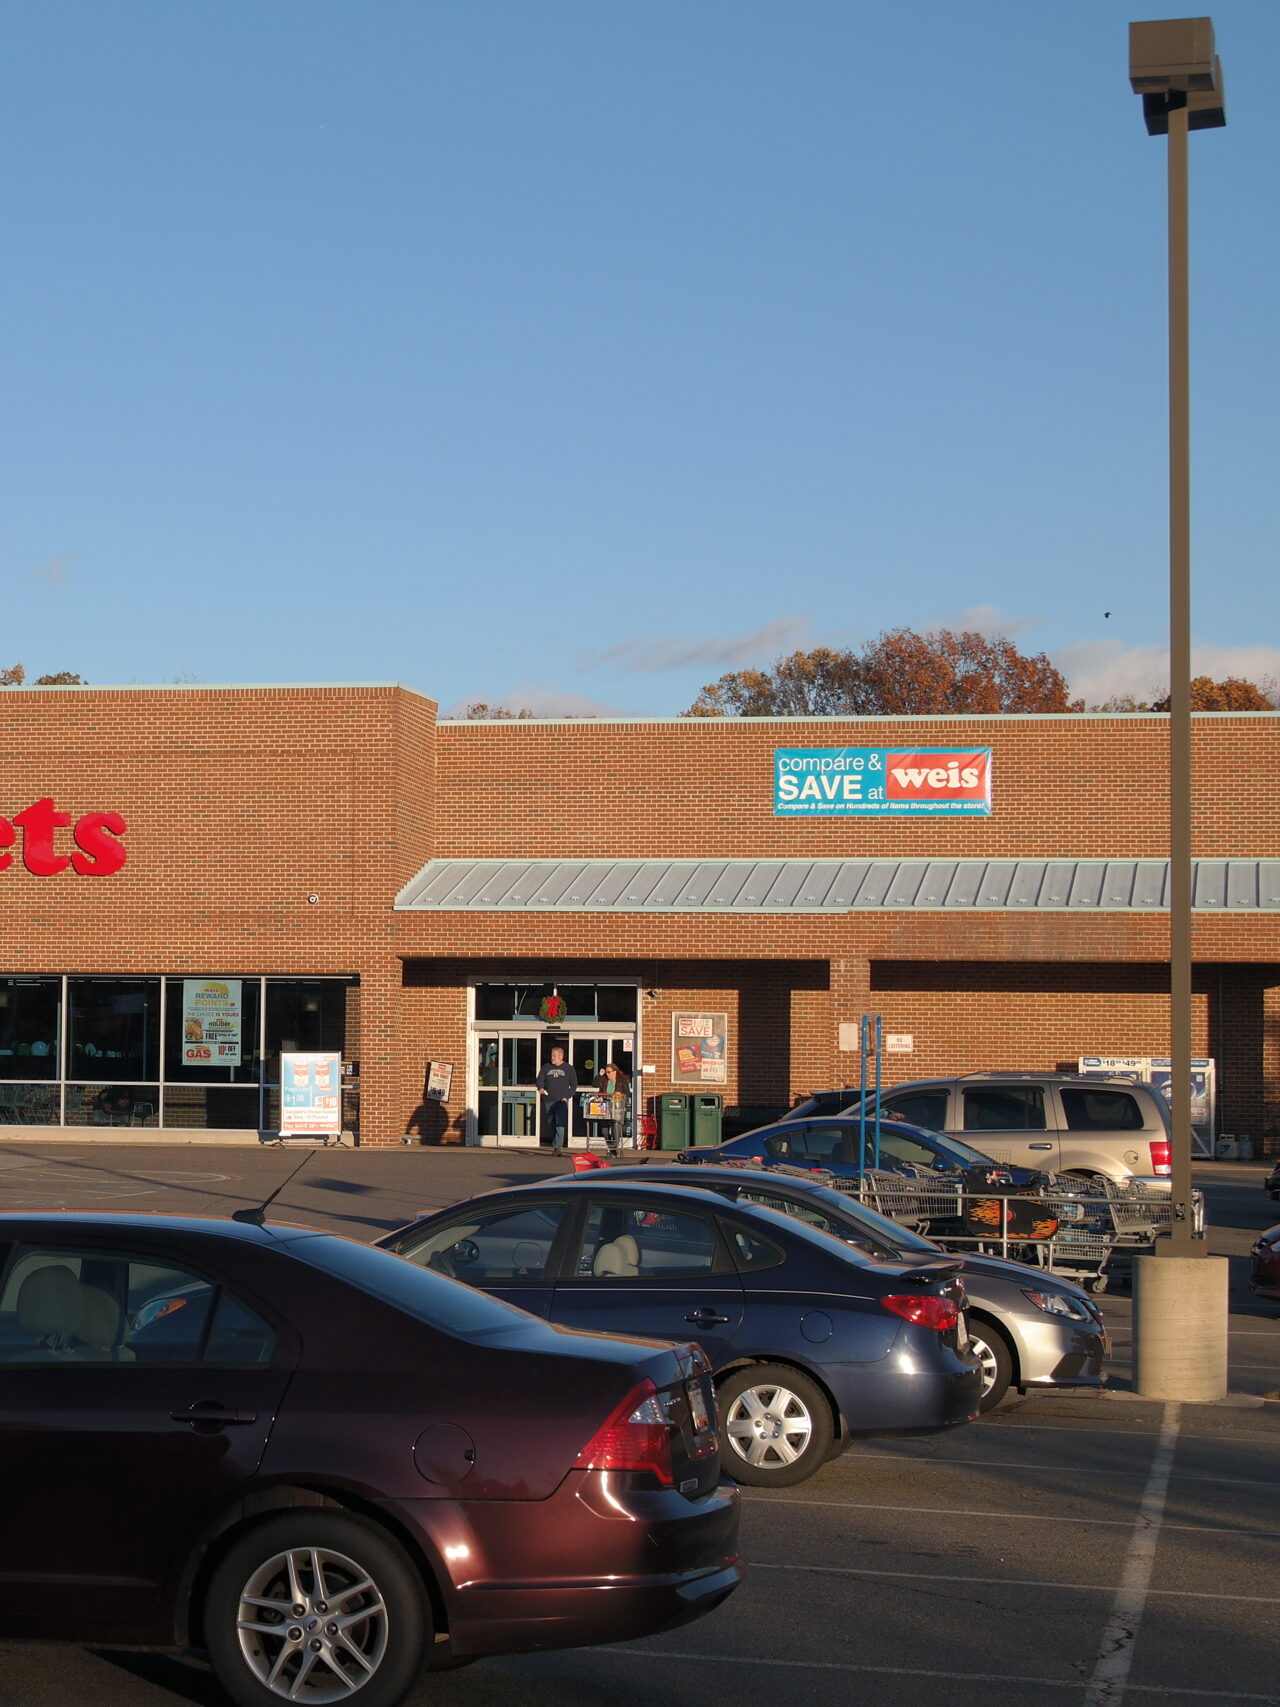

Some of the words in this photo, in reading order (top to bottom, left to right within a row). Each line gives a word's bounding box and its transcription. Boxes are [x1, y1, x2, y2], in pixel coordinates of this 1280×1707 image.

[778, 756, 864, 774] compare
[868, 754, 882, 771] &
[891, 761, 979, 788] weis
[778, 774, 863, 800] SAVE
[868, 786, 884, 800] at
[681, 1027, 710, 1036] SAVE
[186, 1049, 211, 1058] GAS
